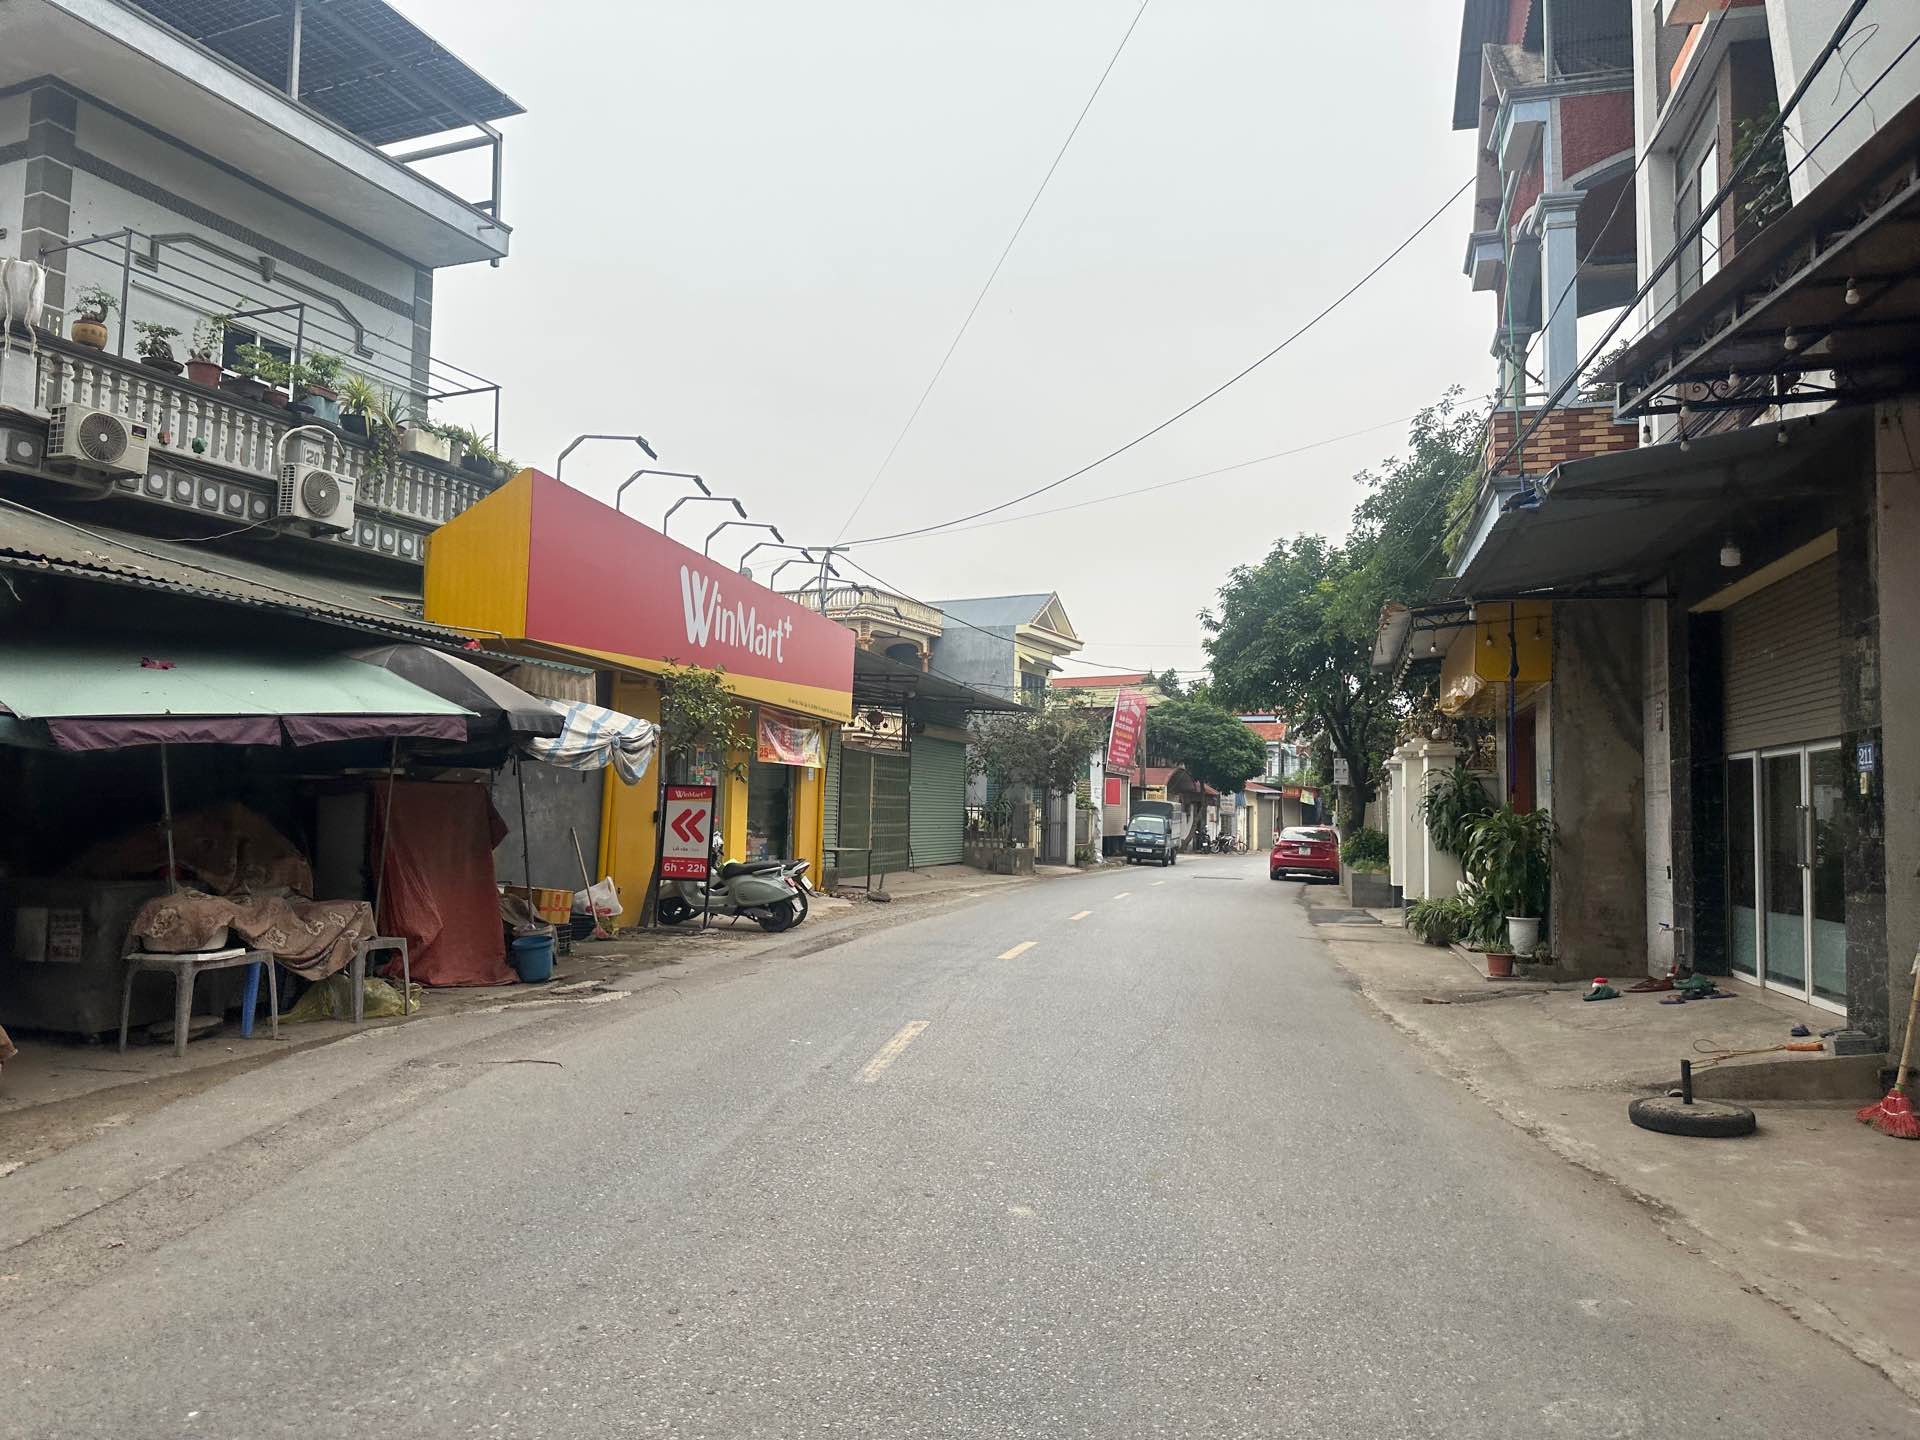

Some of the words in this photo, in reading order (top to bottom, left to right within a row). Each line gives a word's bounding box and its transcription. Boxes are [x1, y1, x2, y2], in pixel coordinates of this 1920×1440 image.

[1858, 747, 1873, 765] 211
[664, 863, 677, 872] 6h
[687, 864, 706, 873] 22h
